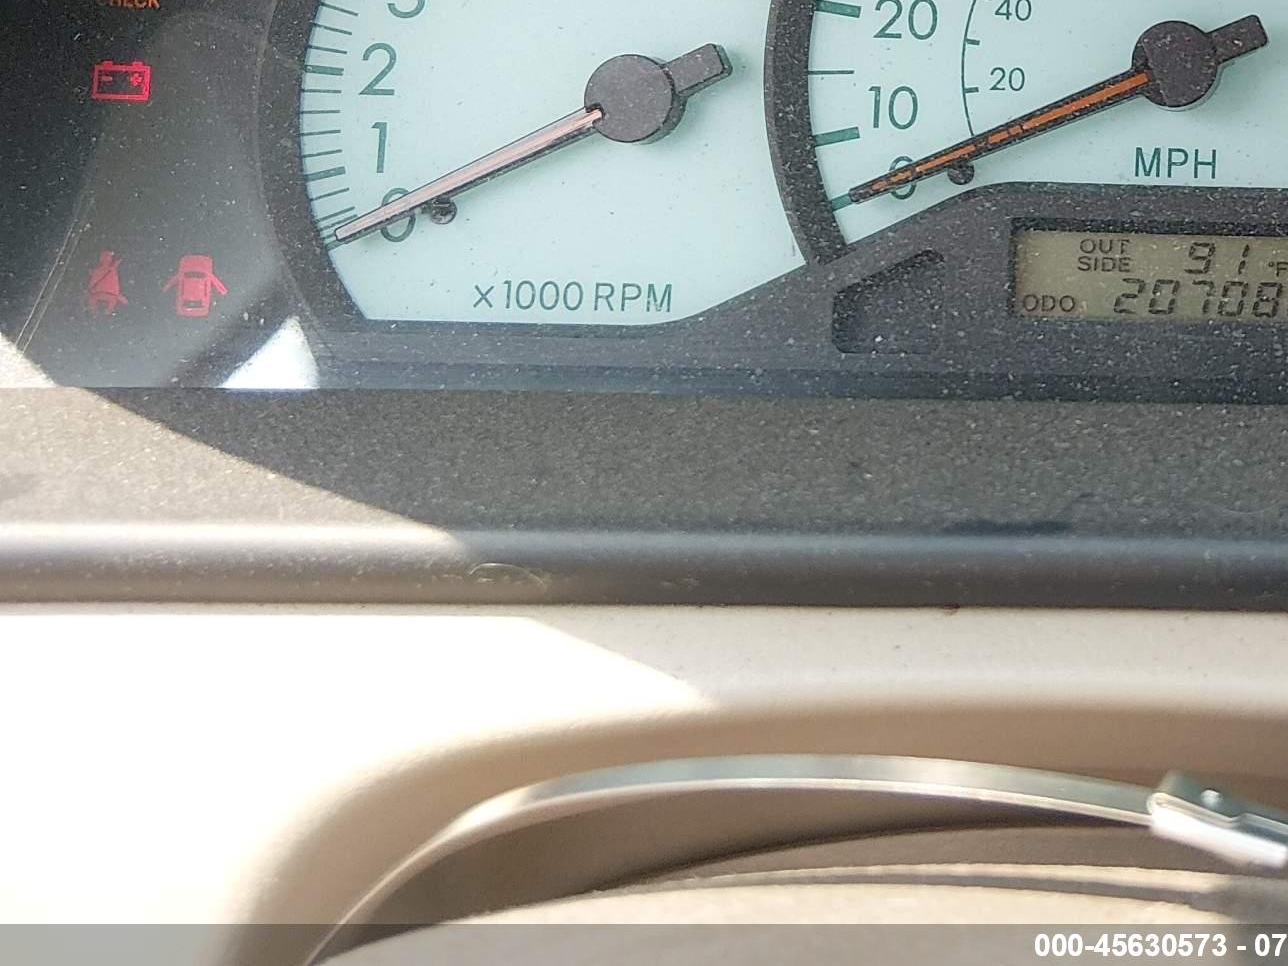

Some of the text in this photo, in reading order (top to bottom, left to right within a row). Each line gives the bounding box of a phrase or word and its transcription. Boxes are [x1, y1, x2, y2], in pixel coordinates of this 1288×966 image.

[358, 43, 396, 95] 2
[990, 67, 1025, 91] 20
[869, 86, 918, 129] 10
[371, 122, 387, 173] 1
[1135, 147, 1216, 179] MPH
[1079, 239, 1131, 255] OUT
[1184, 241, 1251, 275] 91
[1077, 256, 1132, 273] SIDE
[594, 283, 672, 312] RPM
[1021, 294, 1077, 313] ODO
